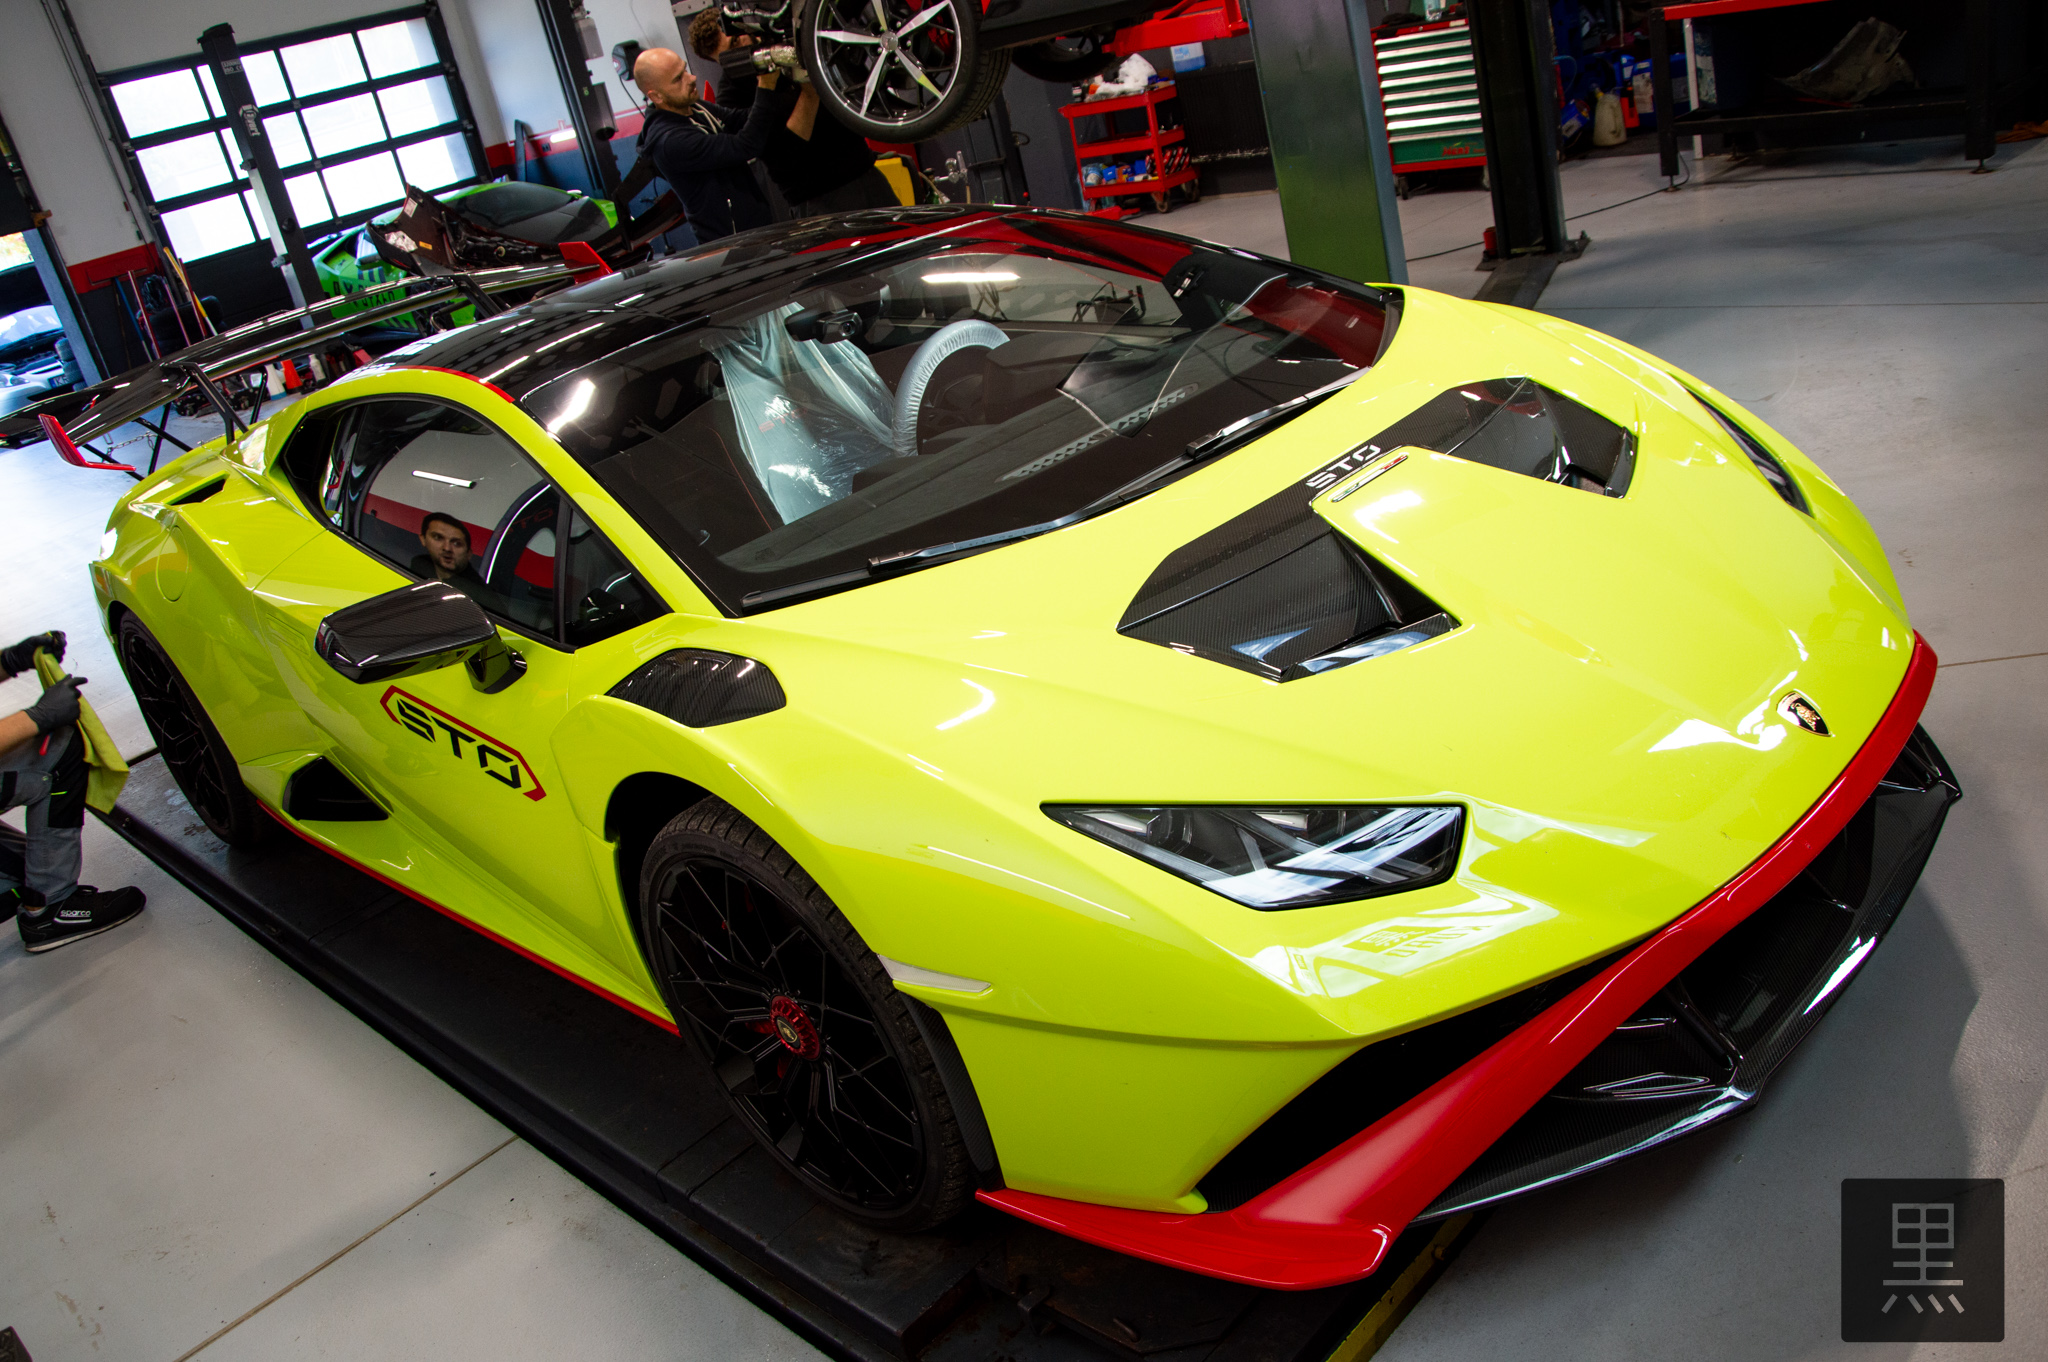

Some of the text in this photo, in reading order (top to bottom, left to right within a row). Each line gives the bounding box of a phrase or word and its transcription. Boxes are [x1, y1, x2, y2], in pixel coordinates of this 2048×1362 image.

[1305, 444, 1381, 489] STO
[397, 698, 523, 790] STO
[60, 910, 92, 918] sparco
